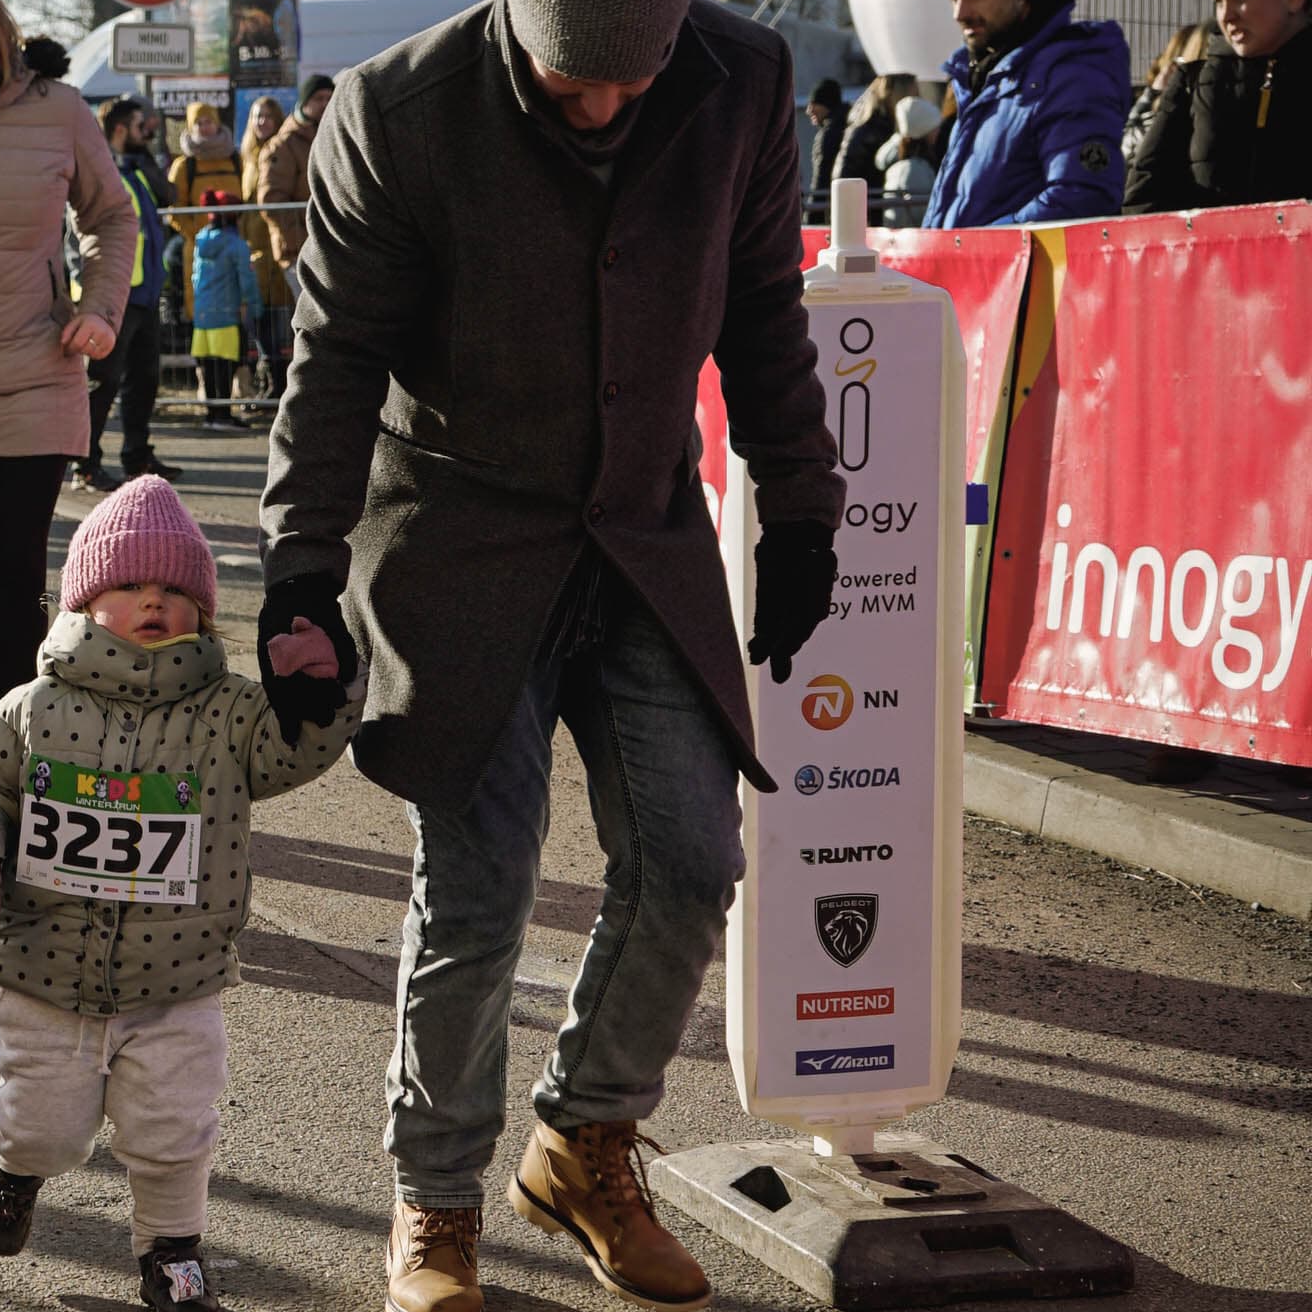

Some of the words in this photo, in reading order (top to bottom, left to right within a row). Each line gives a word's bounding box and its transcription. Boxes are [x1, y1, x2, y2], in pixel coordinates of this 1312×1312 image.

[845, 502, 918, 533] ogy
[861, 593, 915, 613] MVM
[1046, 504, 1312, 692] innogy
[863, 689, 899, 709] NN
[827, 766, 900, 789] ŠKODA
[25, 801, 187, 875] 3237
[818, 844, 894, 865] RUNTO
[820, 899, 873, 909] PEUGEOT
[802, 994, 890, 1015] NUTREND
